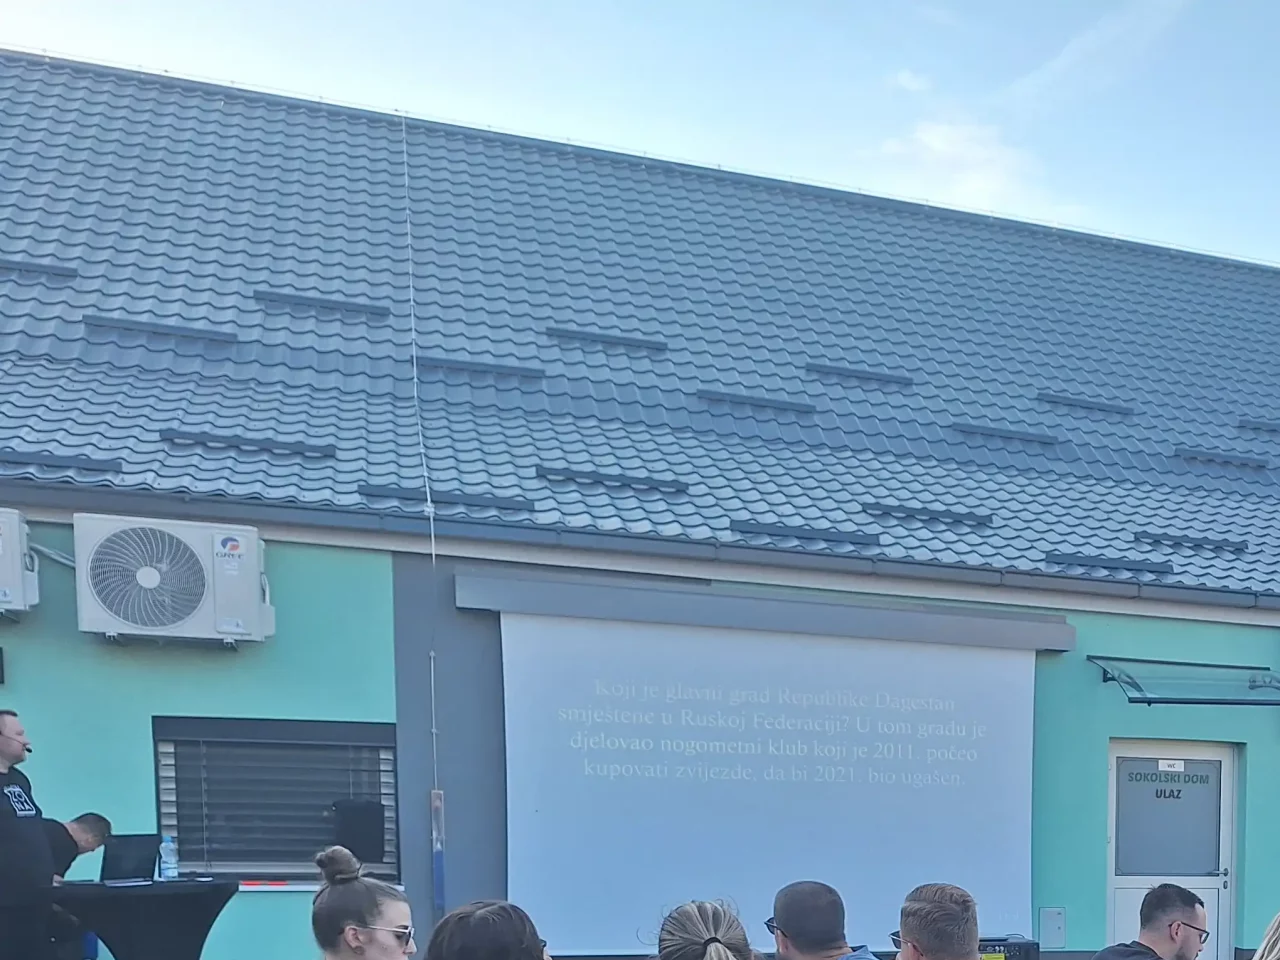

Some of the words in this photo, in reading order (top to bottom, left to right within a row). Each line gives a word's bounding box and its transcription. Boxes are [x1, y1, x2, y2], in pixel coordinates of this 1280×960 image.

[595, 679, 635, 701] Koji
[640, 681, 659, 702] je
[666, 682, 722, 704] glavni
[728, 685, 770, 705] grad
[778, 687, 868, 709] Republike
[875, 691, 955, 713] Dagestan
[558, 704, 654, 726] smještene
[661, 711, 673, 725] u
[681, 709, 746, 732] Ruskoj
[753, 713, 849, 736] Federaciji?
[856, 716, 872, 733] U
[878, 720, 912, 735] tom
[917, 720, 966, 739] gradu
[971, 721, 987, 740] je
[570, 731, 654, 752] djelovao
[661, 737, 761, 757] nogometni
[769, 738, 808, 757] klub
[813, 740, 847, 761] koji
[852, 743, 868, 761] je
[873, 742, 920, 760] 2011.
[926, 745, 978, 764] počeo
[584, 758, 668, 780] kupovati
[675, 761, 757, 783] zvijezde,
[764, 764, 785, 781] da
[792, 765, 807, 781] bi
[814, 766, 862, 783] 2021.
[868, 767, 895, 784] bio
[901, 768, 966, 788] ugašen.
[1127, 772, 1180, 783] SOKOLSKI
[1184, 774, 1209, 784] DOM
[1155, 789, 1182, 799] ULAZ
